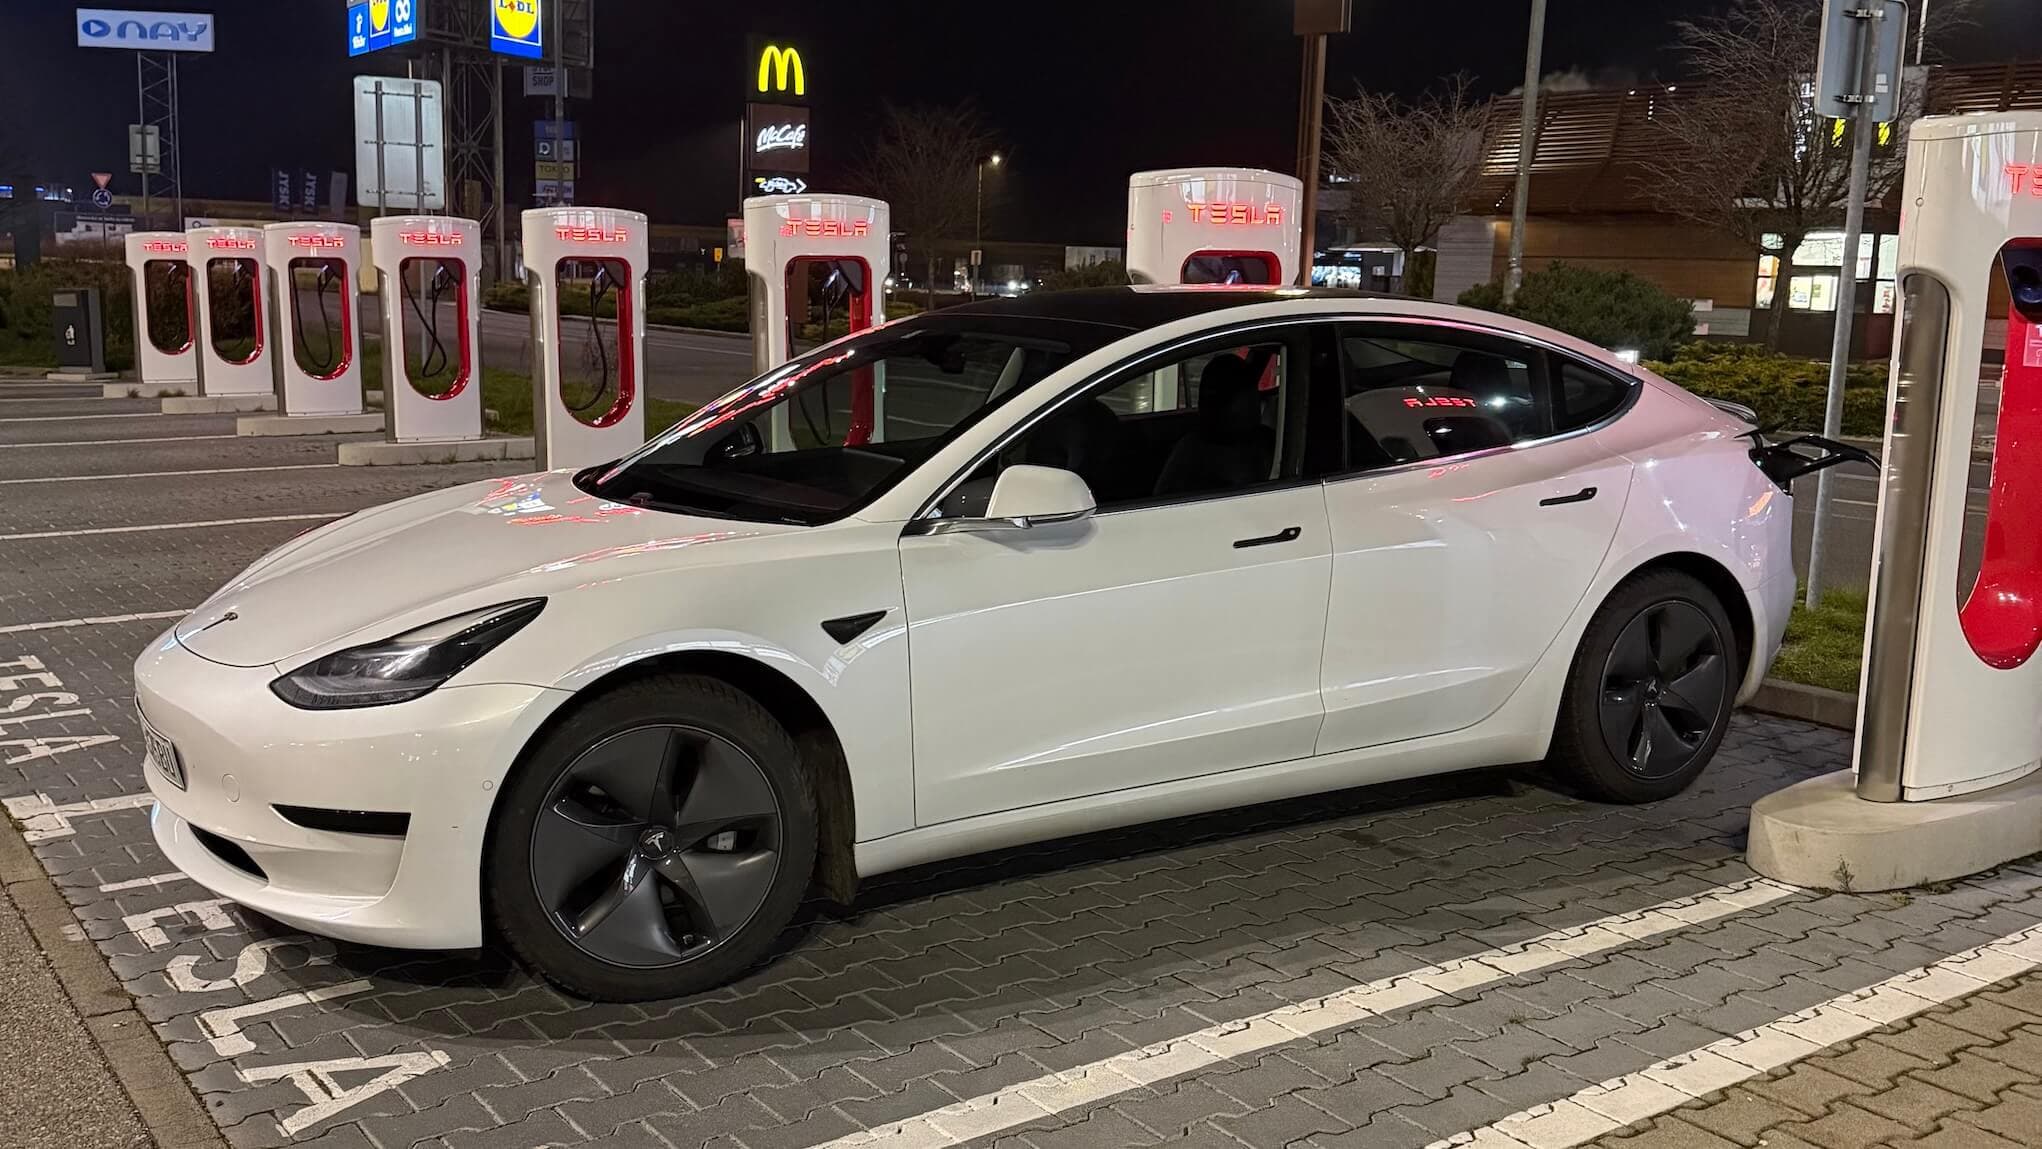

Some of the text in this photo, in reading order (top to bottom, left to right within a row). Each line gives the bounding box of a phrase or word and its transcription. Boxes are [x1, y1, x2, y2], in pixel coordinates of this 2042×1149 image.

[117, 20, 207, 41] NAY
[532, 76, 554, 88] SHOP
[539, 164, 570, 173] TOKO
[279, 170, 290, 210] JYSK
[304, 172, 317, 211] JYSK
[1187, 203, 1282, 225] TESLA
[556, 228, 628, 242] TESLA
[787, 219, 868, 237] TESLA
[206, 239, 256, 250] TESLA
[288, 235, 344, 248] TESLA
[400, 233, 464, 245] TESLA
[144, 241, 187, 252] TESLA
[0, 655, 121, 765] TESLA
